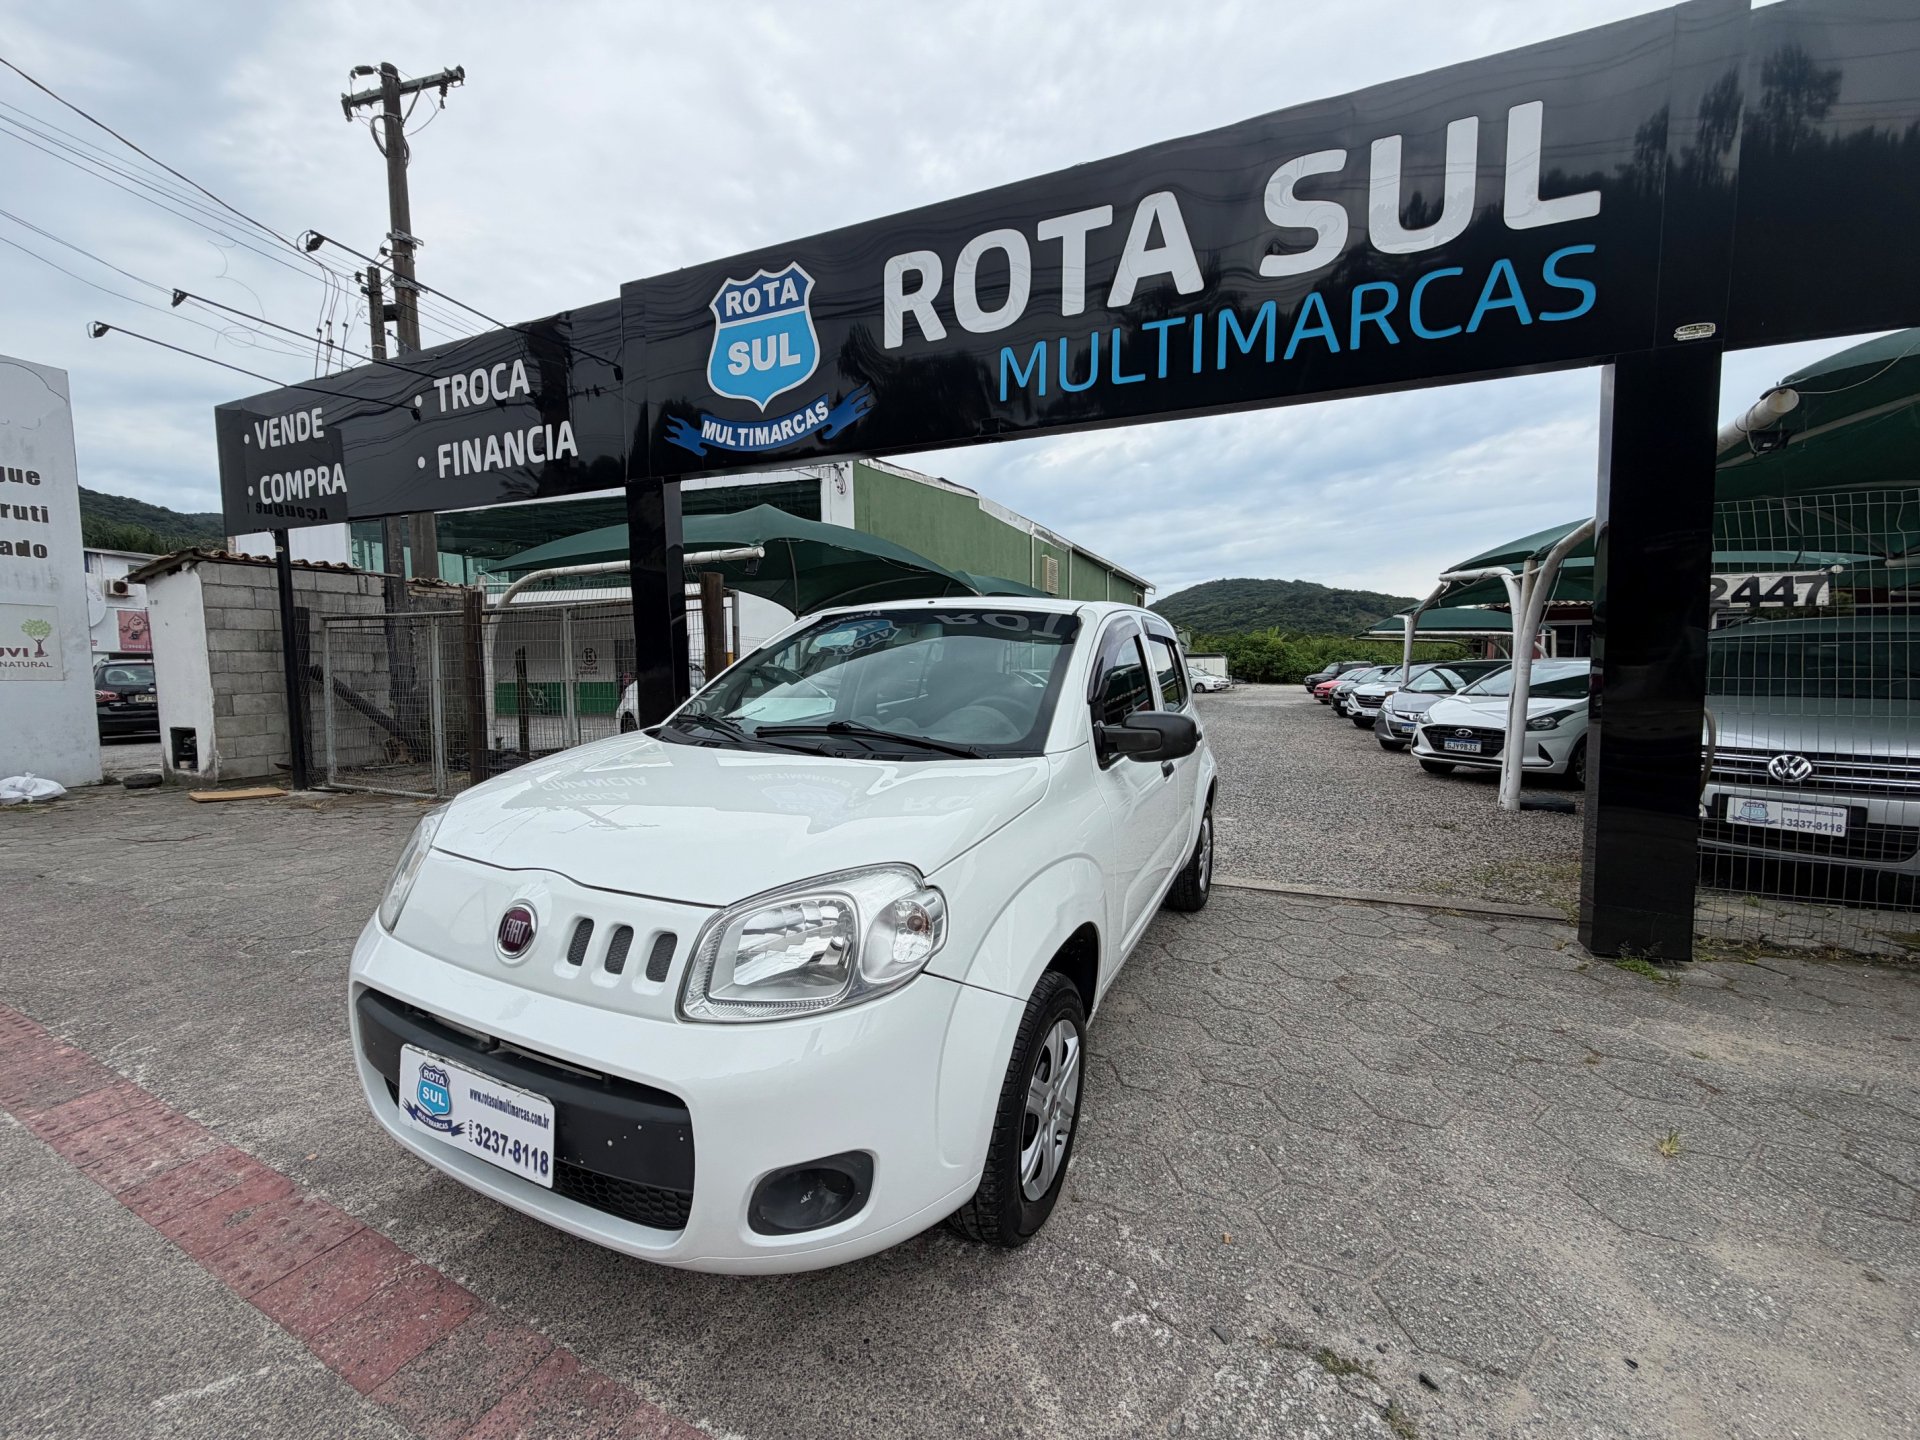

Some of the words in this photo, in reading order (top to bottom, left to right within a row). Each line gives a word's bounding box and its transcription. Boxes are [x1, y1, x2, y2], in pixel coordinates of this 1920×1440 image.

[884, 190, 1204, 349] ROTA
[1259, 100, 1601, 277] SUL
[725, 277, 799, 317] ROTA
[1000, 244, 1596, 401] MULTIMARCAS
[727, 332, 801, 376] SUL
[434, 359, 531, 412] TROCA
[254, 407, 324, 450] VENDE
[701, 401, 829, 446] MULTIMARCAS
[438, 420, 578, 479] FINANCIA
[260, 463, 347, 505] COMPRA
[504, 918, 529, 945] FIAT
[422, 1086, 446, 1107] SUL
[423, 1069, 445, 1086] ROTA
[469, 1088, 550, 1130] www.rotasulmultimarcas.com.br
[475, 1123, 550, 1175] 3237-8118
